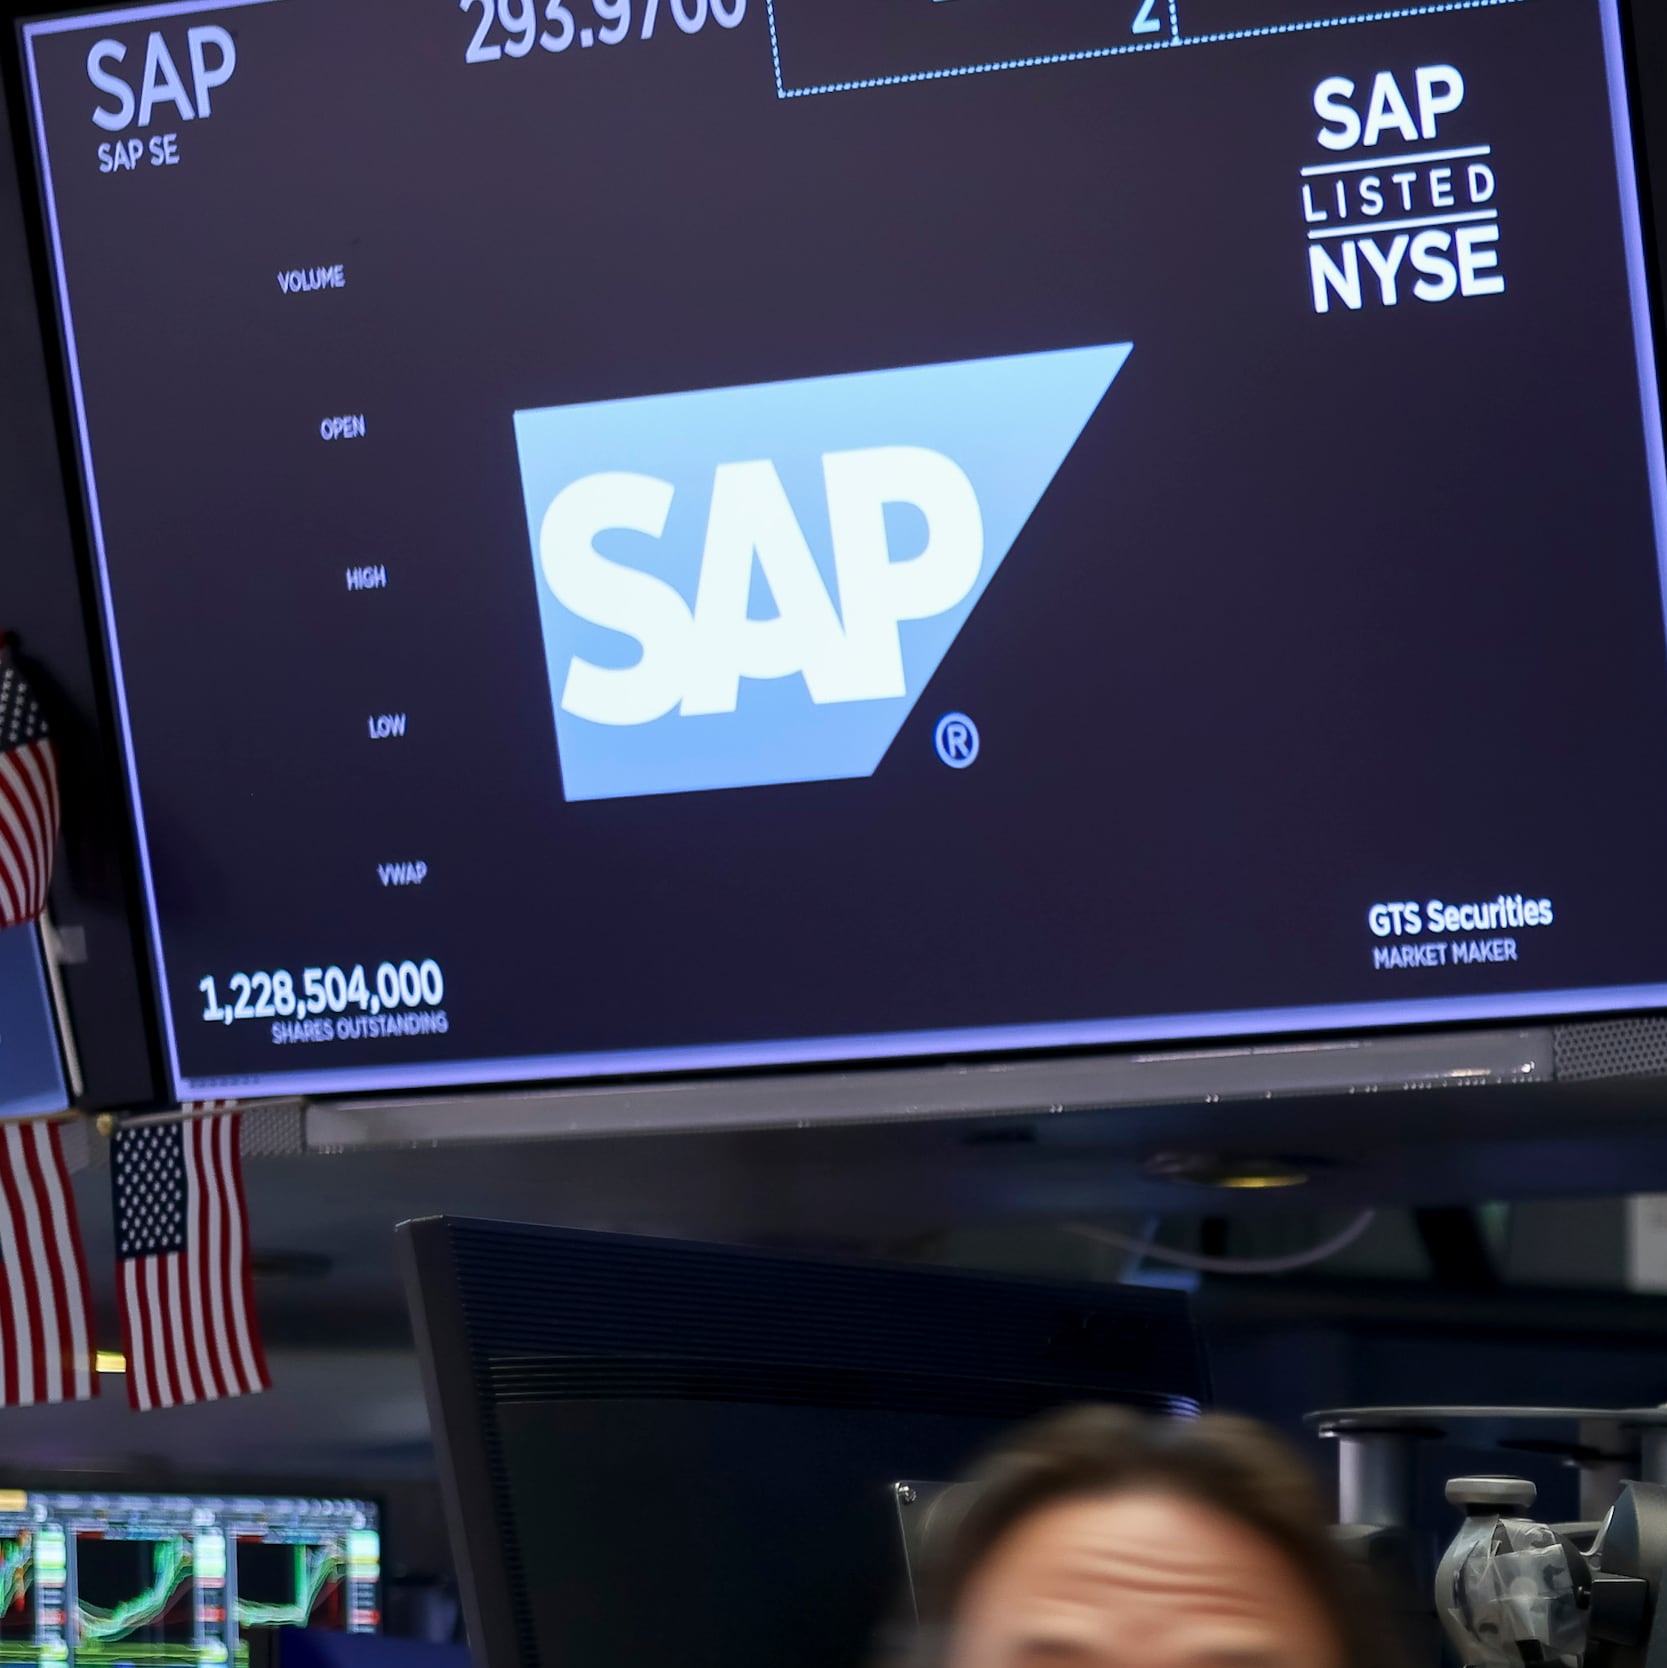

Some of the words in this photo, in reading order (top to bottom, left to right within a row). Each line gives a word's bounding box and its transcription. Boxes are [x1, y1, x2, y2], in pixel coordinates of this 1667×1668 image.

[86, 25, 236, 131] SAP
[1313, 64, 1466, 152] SAP
[97, 139, 144, 173] SAP
[150, 134, 181, 166] SE
[1301, 163, 1497, 224] LISTED
[277, 264, 346, 294] VOLUME
[1307, 225, 1506, 314] NYSE
[320, 414, 365, 440] OPEN
[346, 565, 387, 591] HIGH
[540, 444, 984, 726] SAP
[368, 714, 406, 739] LOW
[378, 861, 427, 886] VWAP
[1368, 901, 1422, 937] GTS
[1426, 894, 1553, 933] Securities
[1373, 942, 1447, 970] MARKET
[1450, 938, 1518, 966] MAKER
[199, 959, 444, 1026] 1,228,504,000
[272, 1017, 334, 1045] SHARES
[336, 1010, 449, 1041] OUTSTANDING
